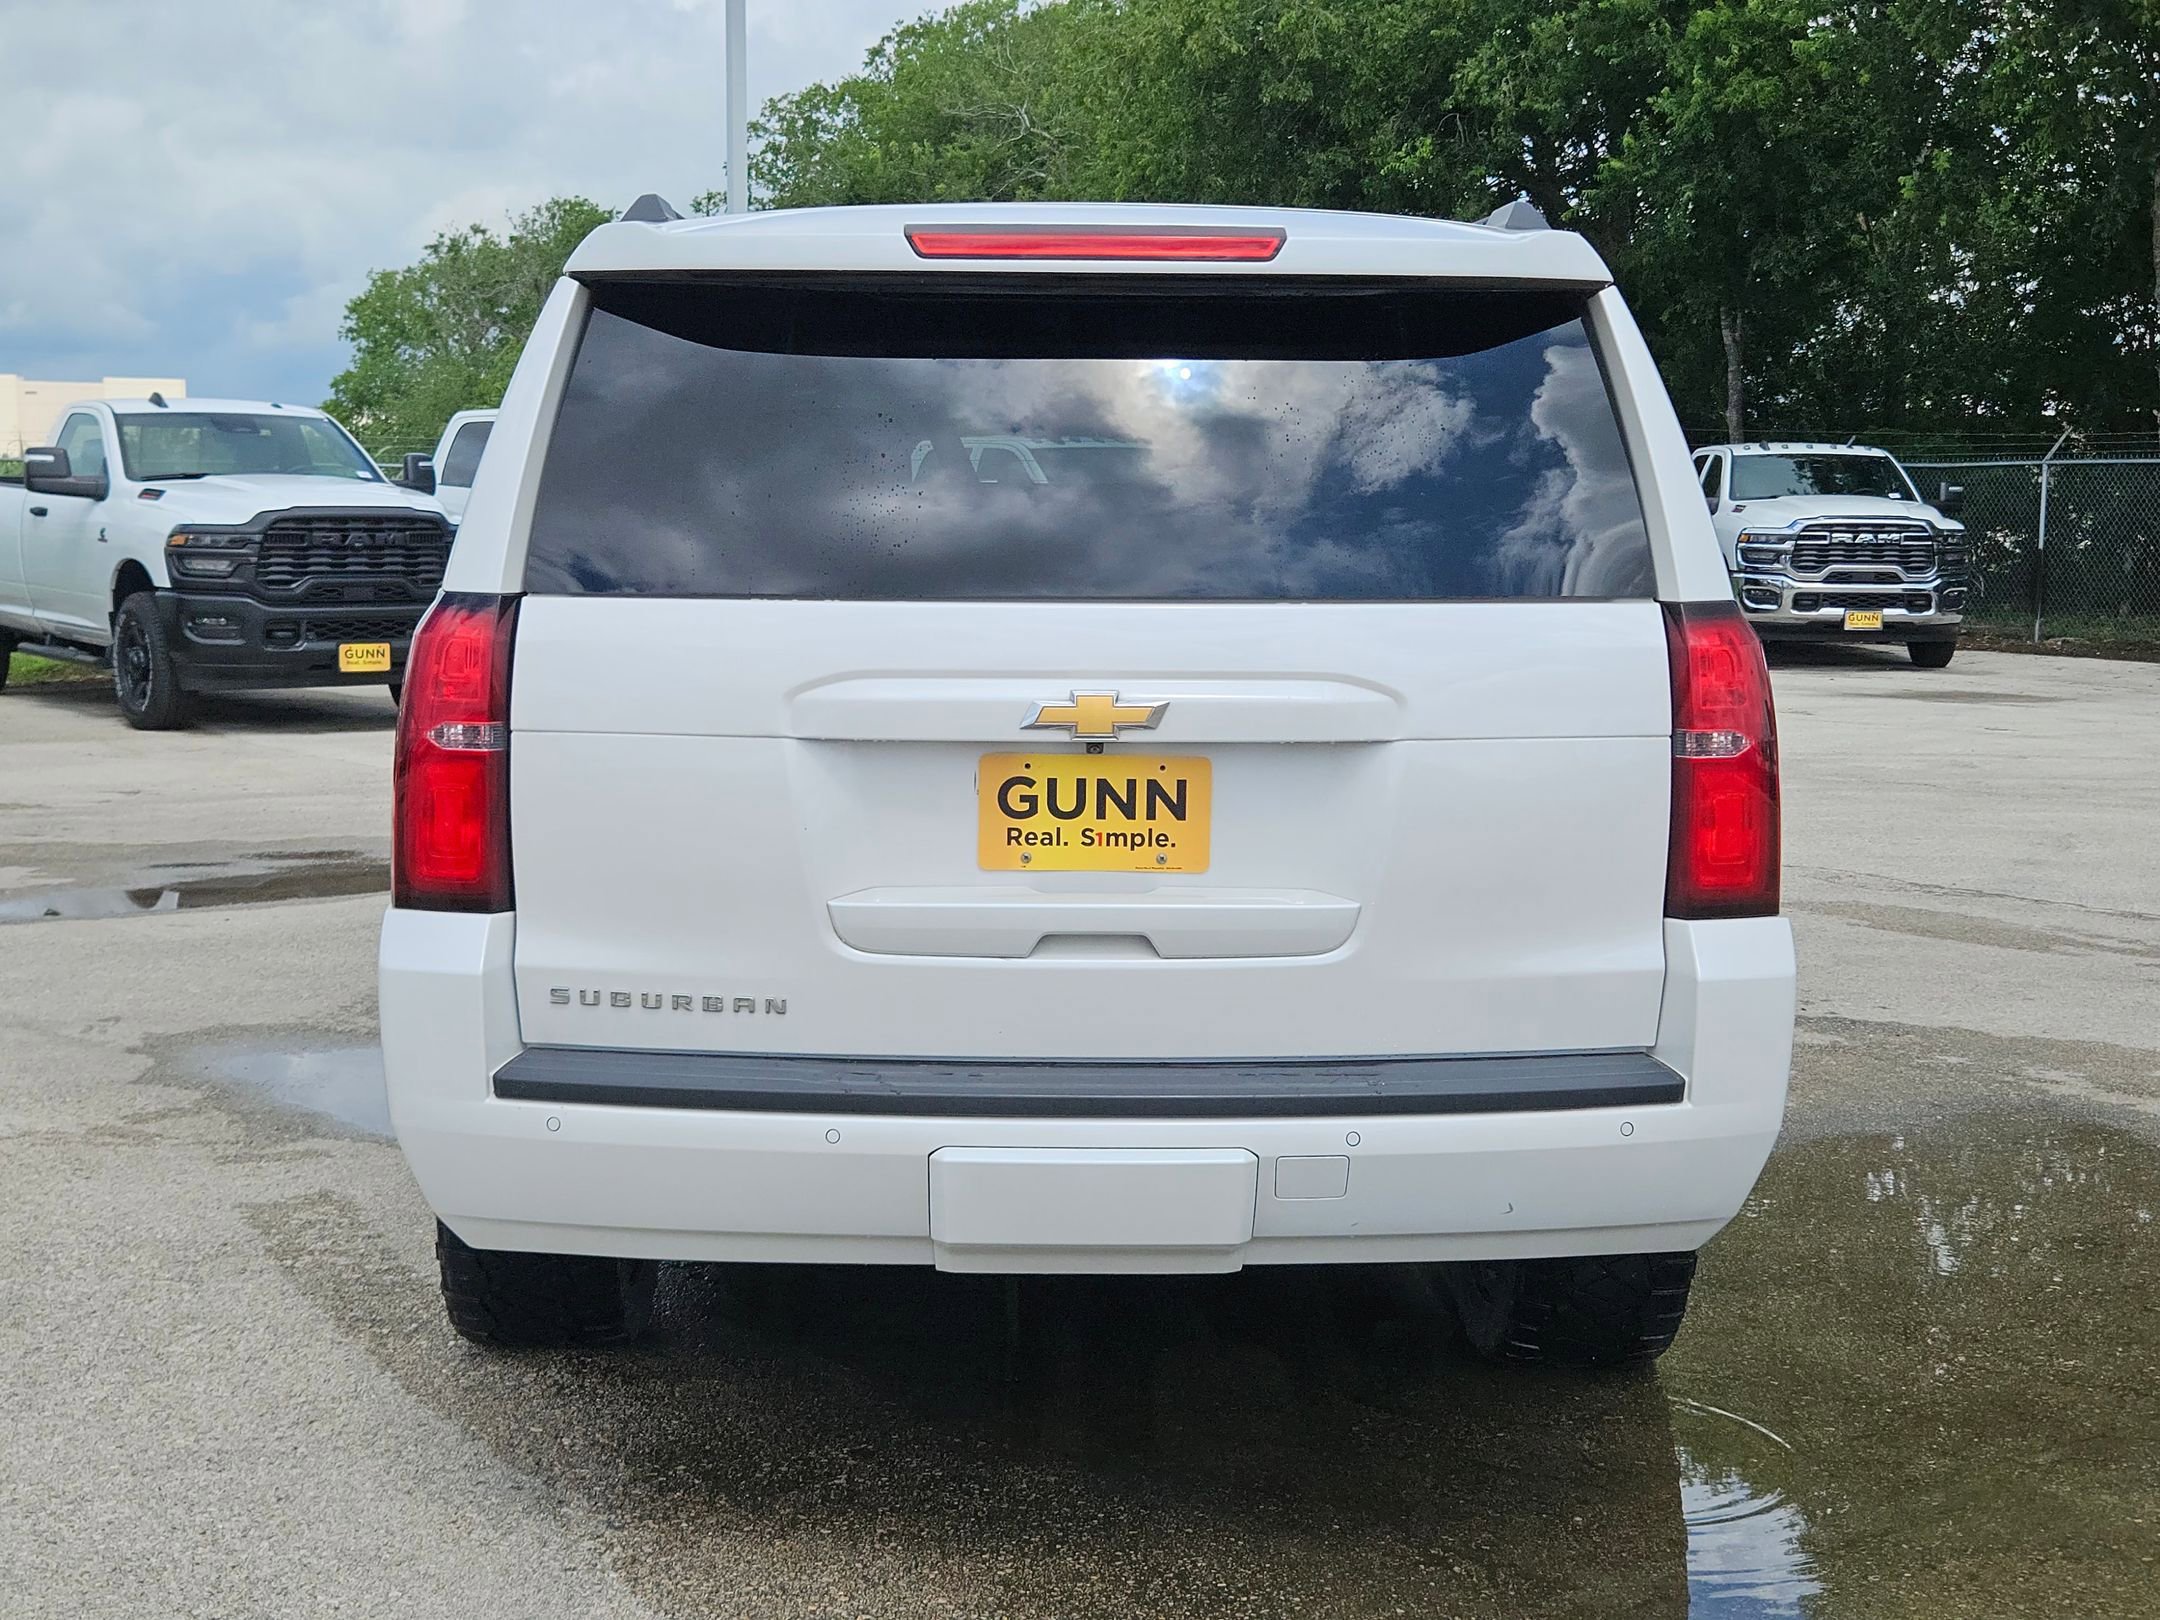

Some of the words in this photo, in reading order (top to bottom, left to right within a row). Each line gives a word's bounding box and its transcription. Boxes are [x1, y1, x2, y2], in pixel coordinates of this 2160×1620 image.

[1831, 533, 1900, 544] RAM
[344, 648, 385, 659] GUNN
[997, 776, 1187, 821] GUNN
[1006, 827, 1069, 847] Real.
[549, 987, 787, 1014] SUBURBAN
